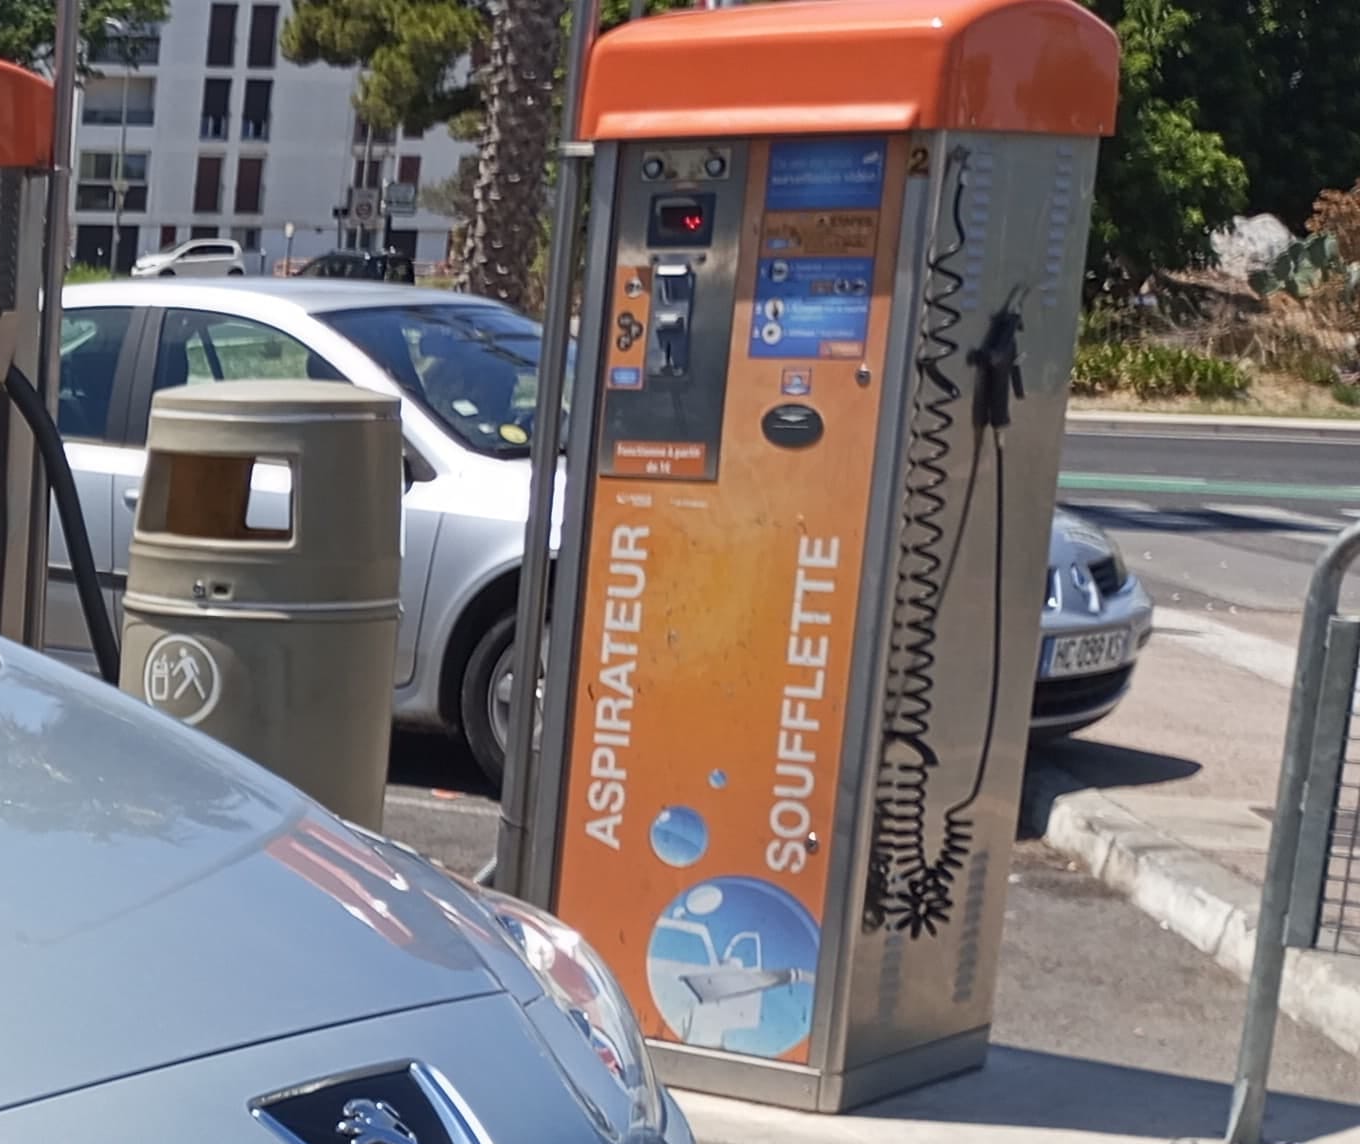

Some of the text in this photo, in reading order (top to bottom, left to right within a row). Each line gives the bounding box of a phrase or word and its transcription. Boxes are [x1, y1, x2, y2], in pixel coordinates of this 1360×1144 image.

[909, 147, 930, 175] 2
[585, 523, 651, 850] ASPIRATEUR
[765, 535, 840, 875] SOUFFLETTE
